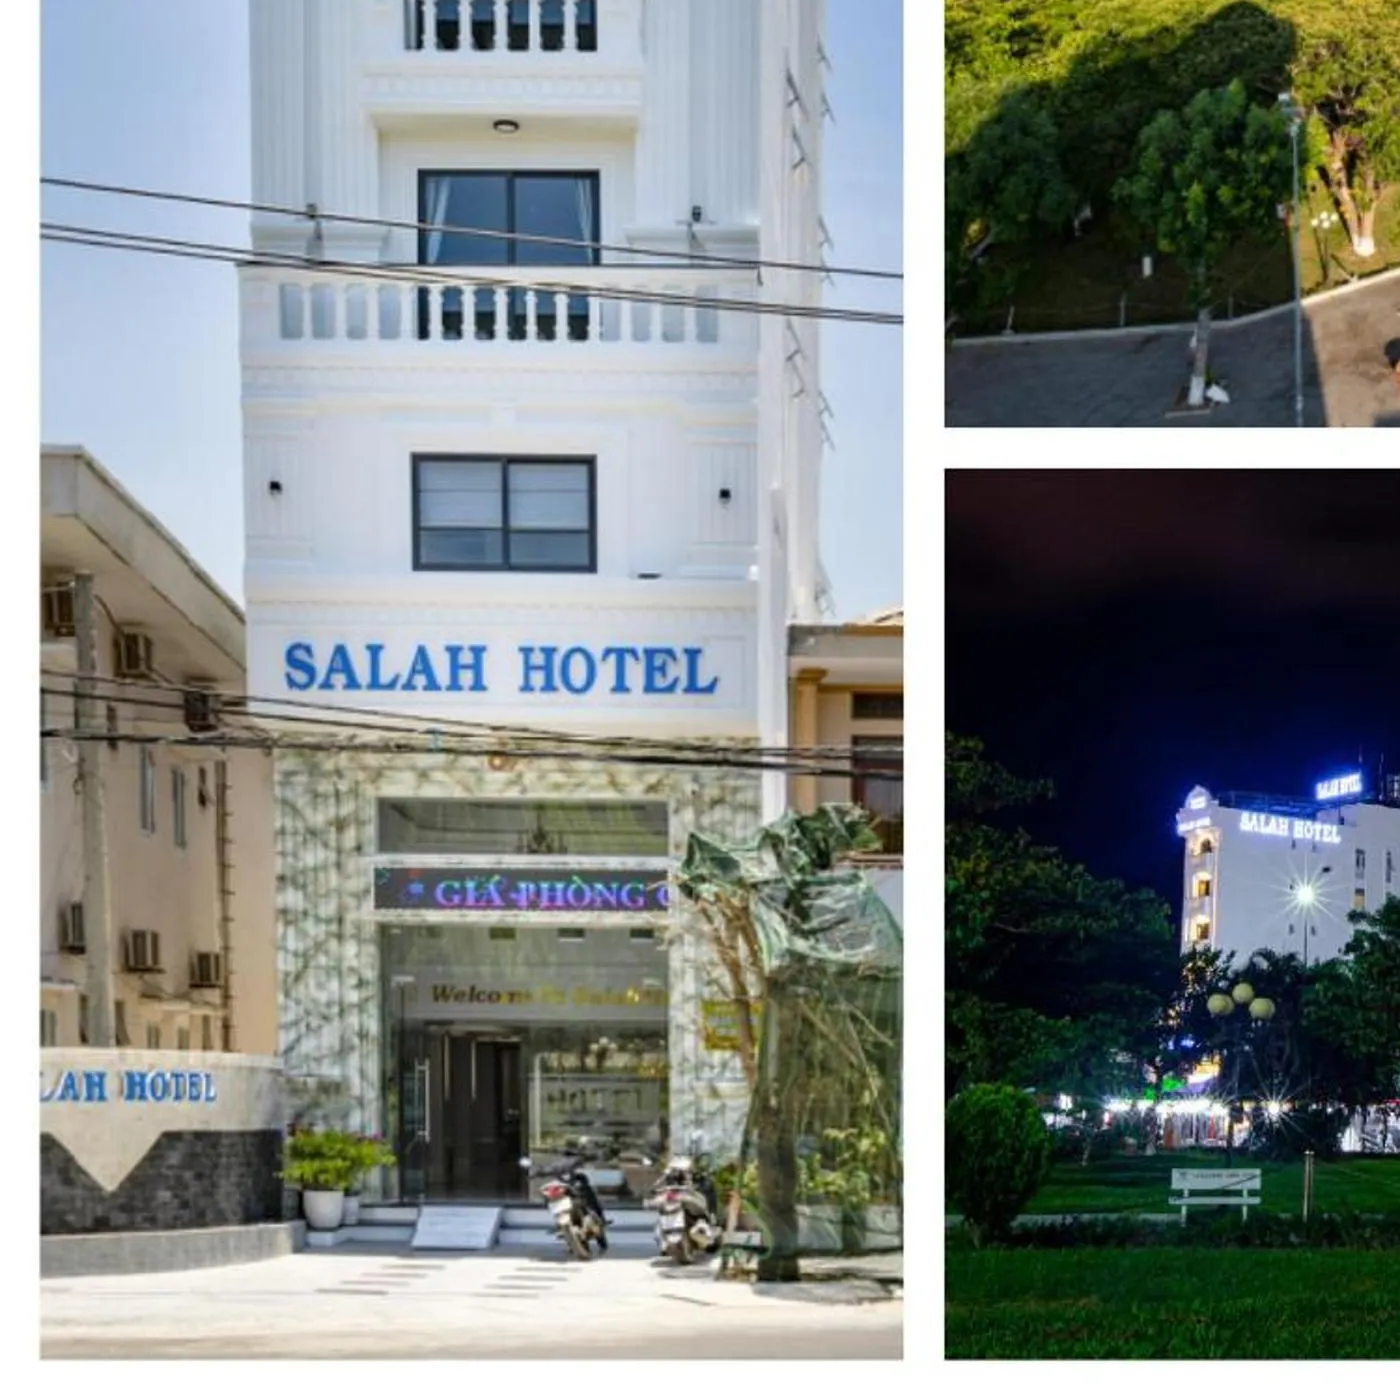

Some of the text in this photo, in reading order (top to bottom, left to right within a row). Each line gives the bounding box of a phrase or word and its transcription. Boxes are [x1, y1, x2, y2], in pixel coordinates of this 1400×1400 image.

[284, 641, 719, 696] SALAH HOTEL
[1240, 812, 1341, 843] SALAH HOTEL
[123, 1070, 217, 1102] HOTEL
